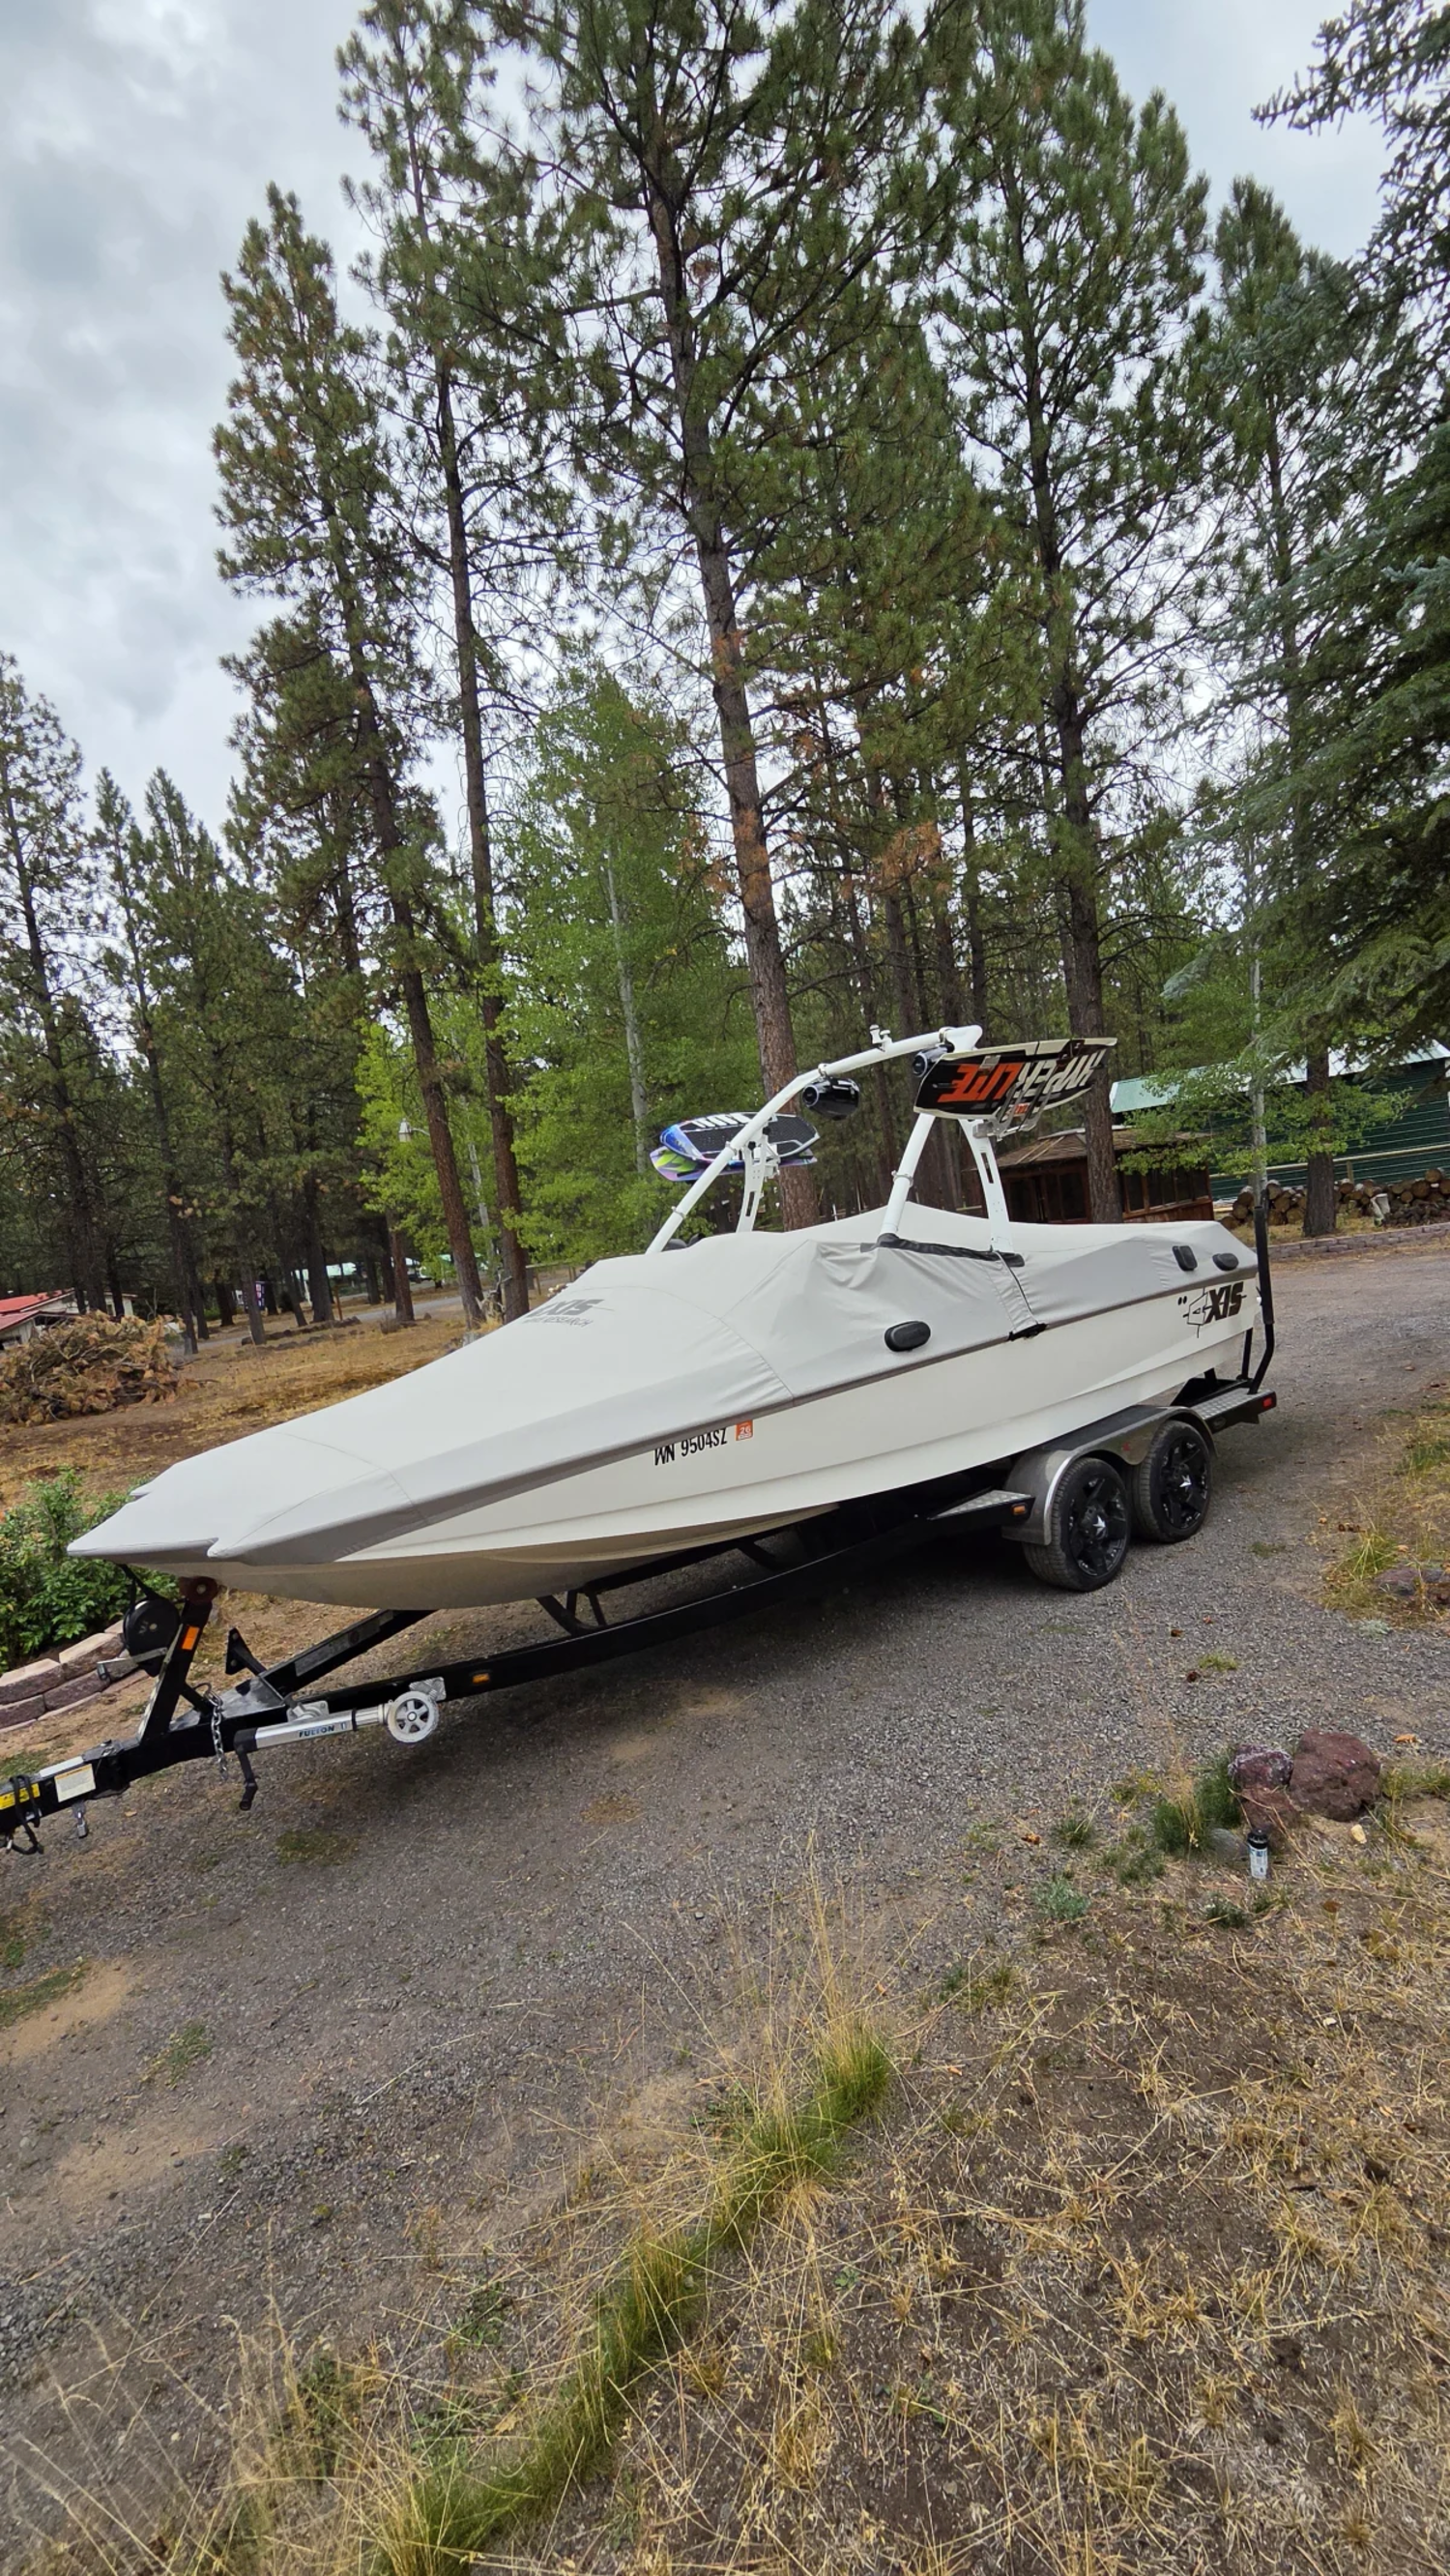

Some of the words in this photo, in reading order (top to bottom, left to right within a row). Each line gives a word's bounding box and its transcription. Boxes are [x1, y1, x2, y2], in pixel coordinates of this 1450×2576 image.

[937, 1049, 1107, 1103] HYPERLITE
[654, 1444, 675, 1466] WN
[681, 1428, 728, 1457] 9504SZ
[299, 1724, 335, 1738] FULTON
